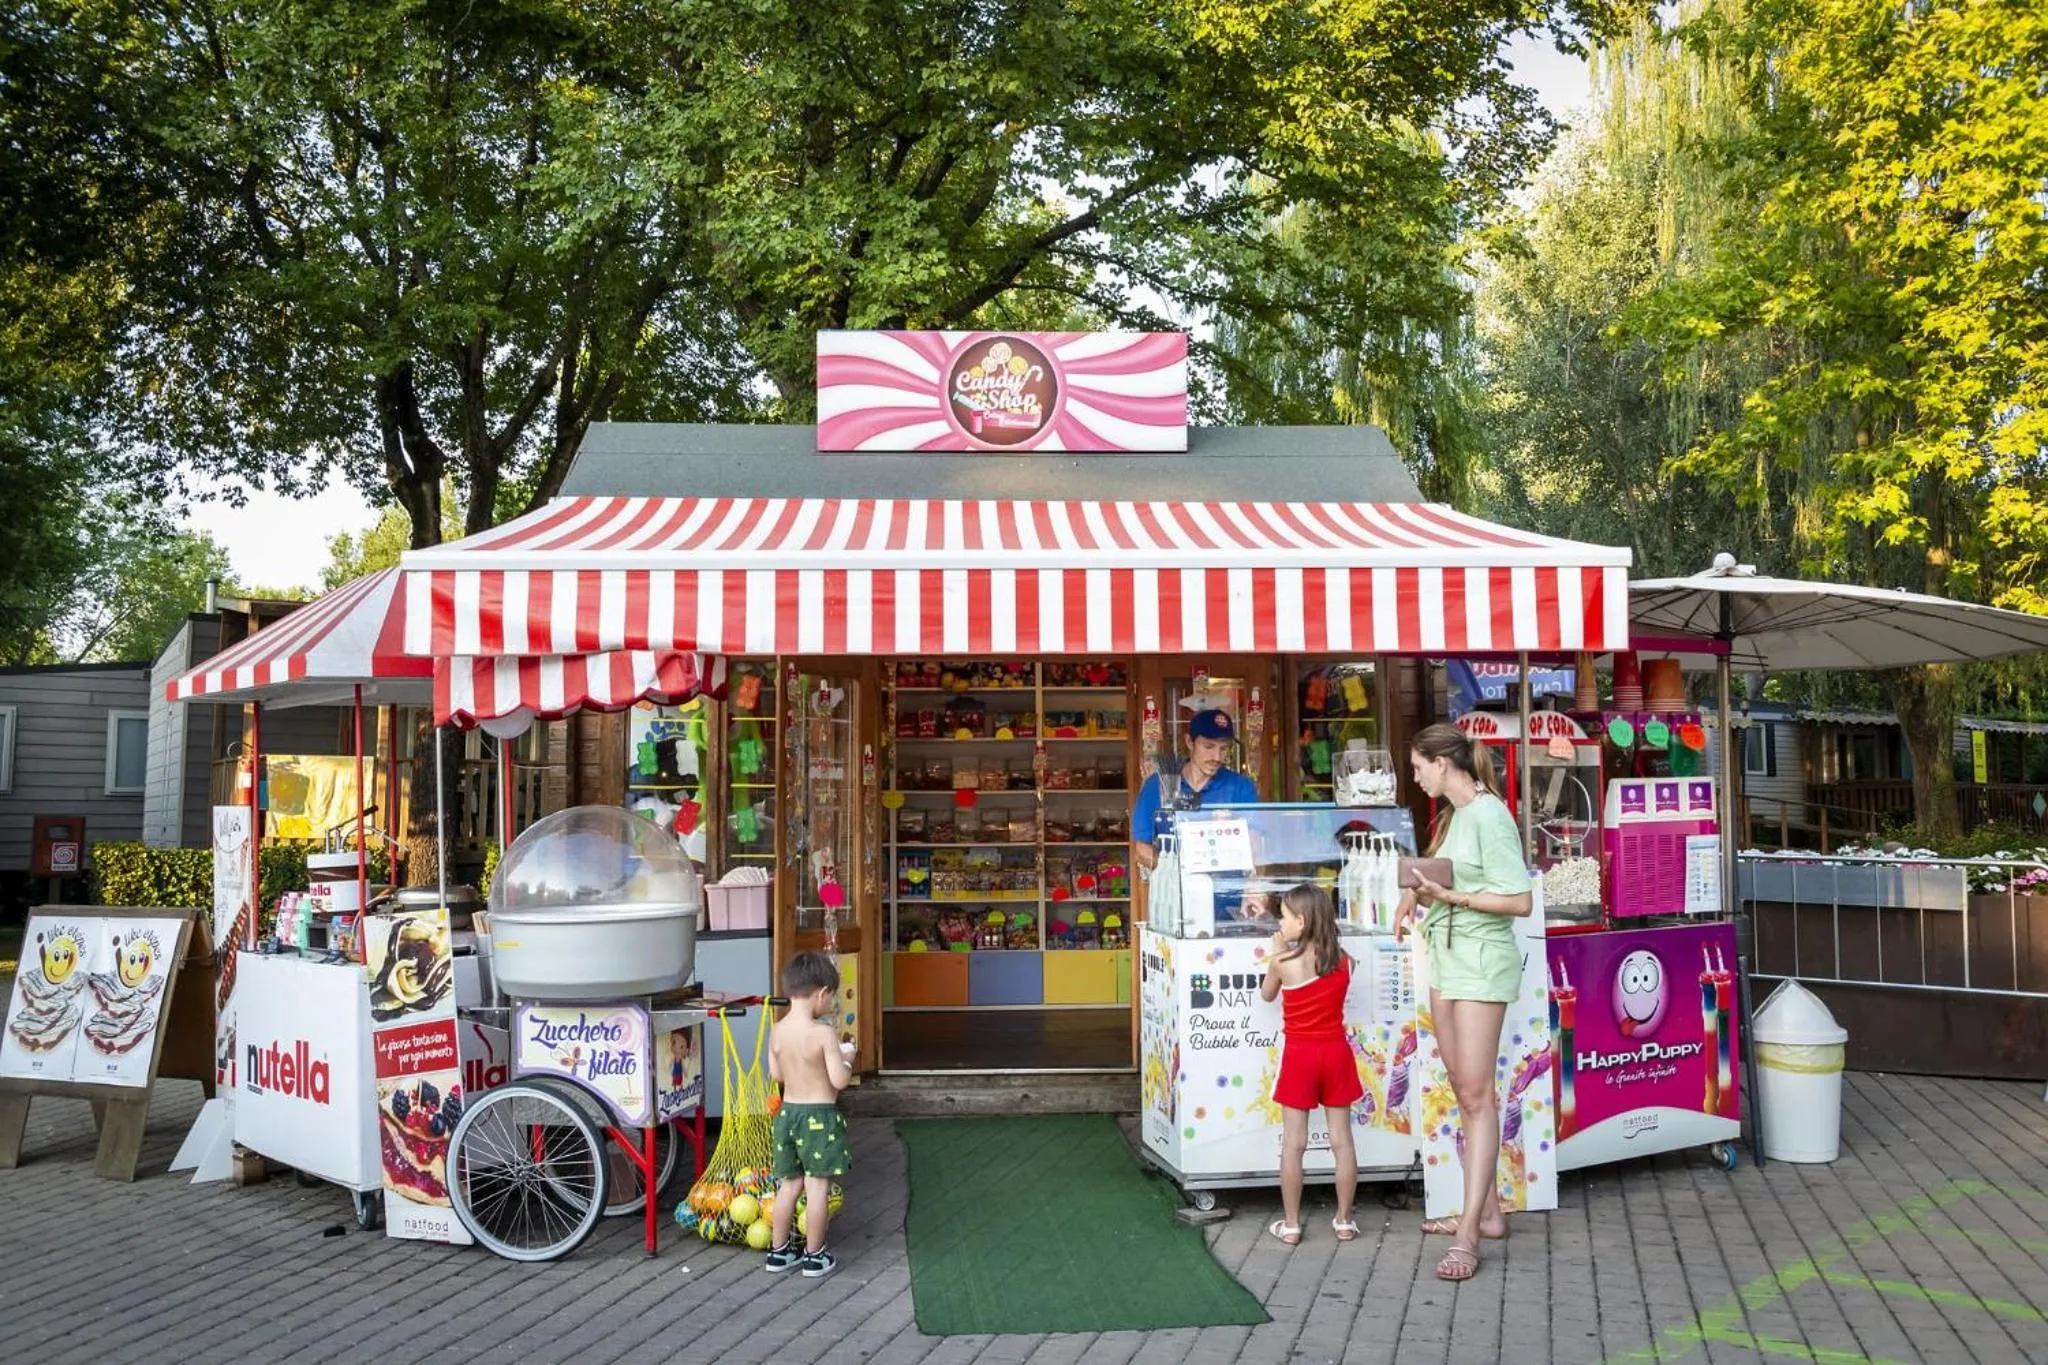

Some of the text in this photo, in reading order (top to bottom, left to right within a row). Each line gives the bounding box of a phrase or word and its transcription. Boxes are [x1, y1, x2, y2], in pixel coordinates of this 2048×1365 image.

[956, 366, 1026, 393] Candy
[987, 389, 1037, 412] Shop
[1473, 716, 1498, 736] CORN
[1529, 714, 1575, 738] OP CORN
[1219, 991, 1254, 1008] NAT
[529, 1012, 622, 1049] Zucchero
[1189, 1013, 1251, 1031] Prova il
[1189, 1031, 1279, 1051] Bubble Tea!
[246, 1039, 330, 1105] nutella
[588, 1048, 637, 1082] filato
